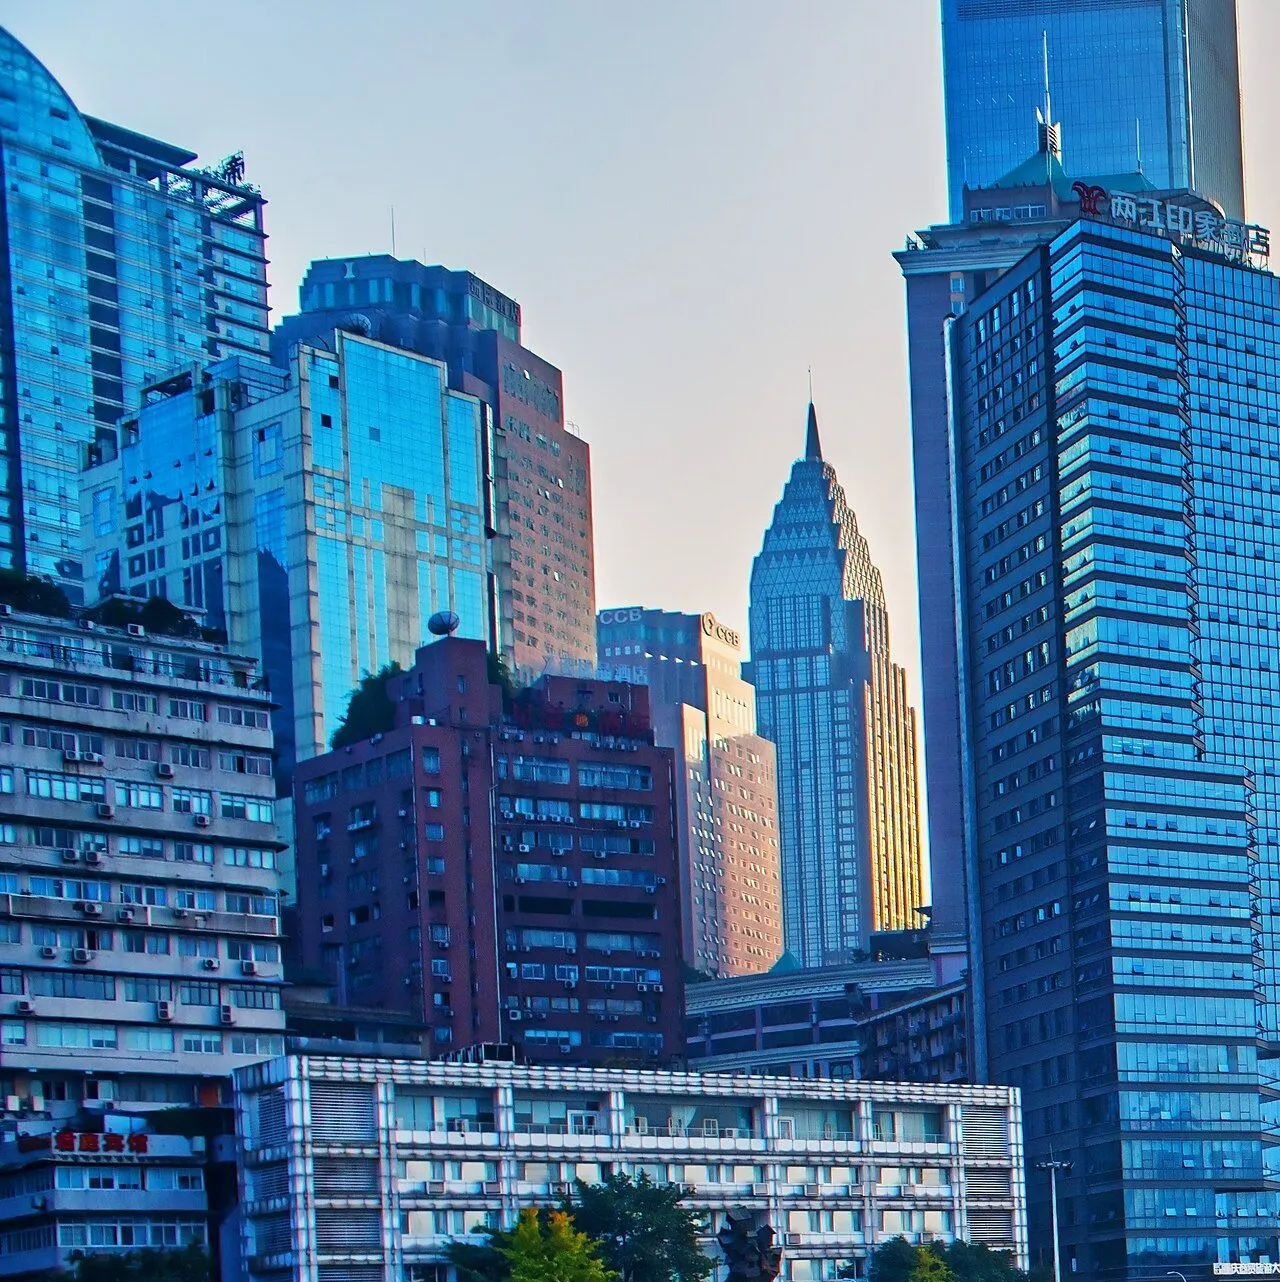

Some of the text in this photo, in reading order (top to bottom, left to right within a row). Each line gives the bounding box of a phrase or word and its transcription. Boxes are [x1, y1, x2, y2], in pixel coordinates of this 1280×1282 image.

[1111, 190, 1270, 256] 两江印象酒店
[600, 609, 642, 625] CCB
[717, 628, 740, 646] CCB
